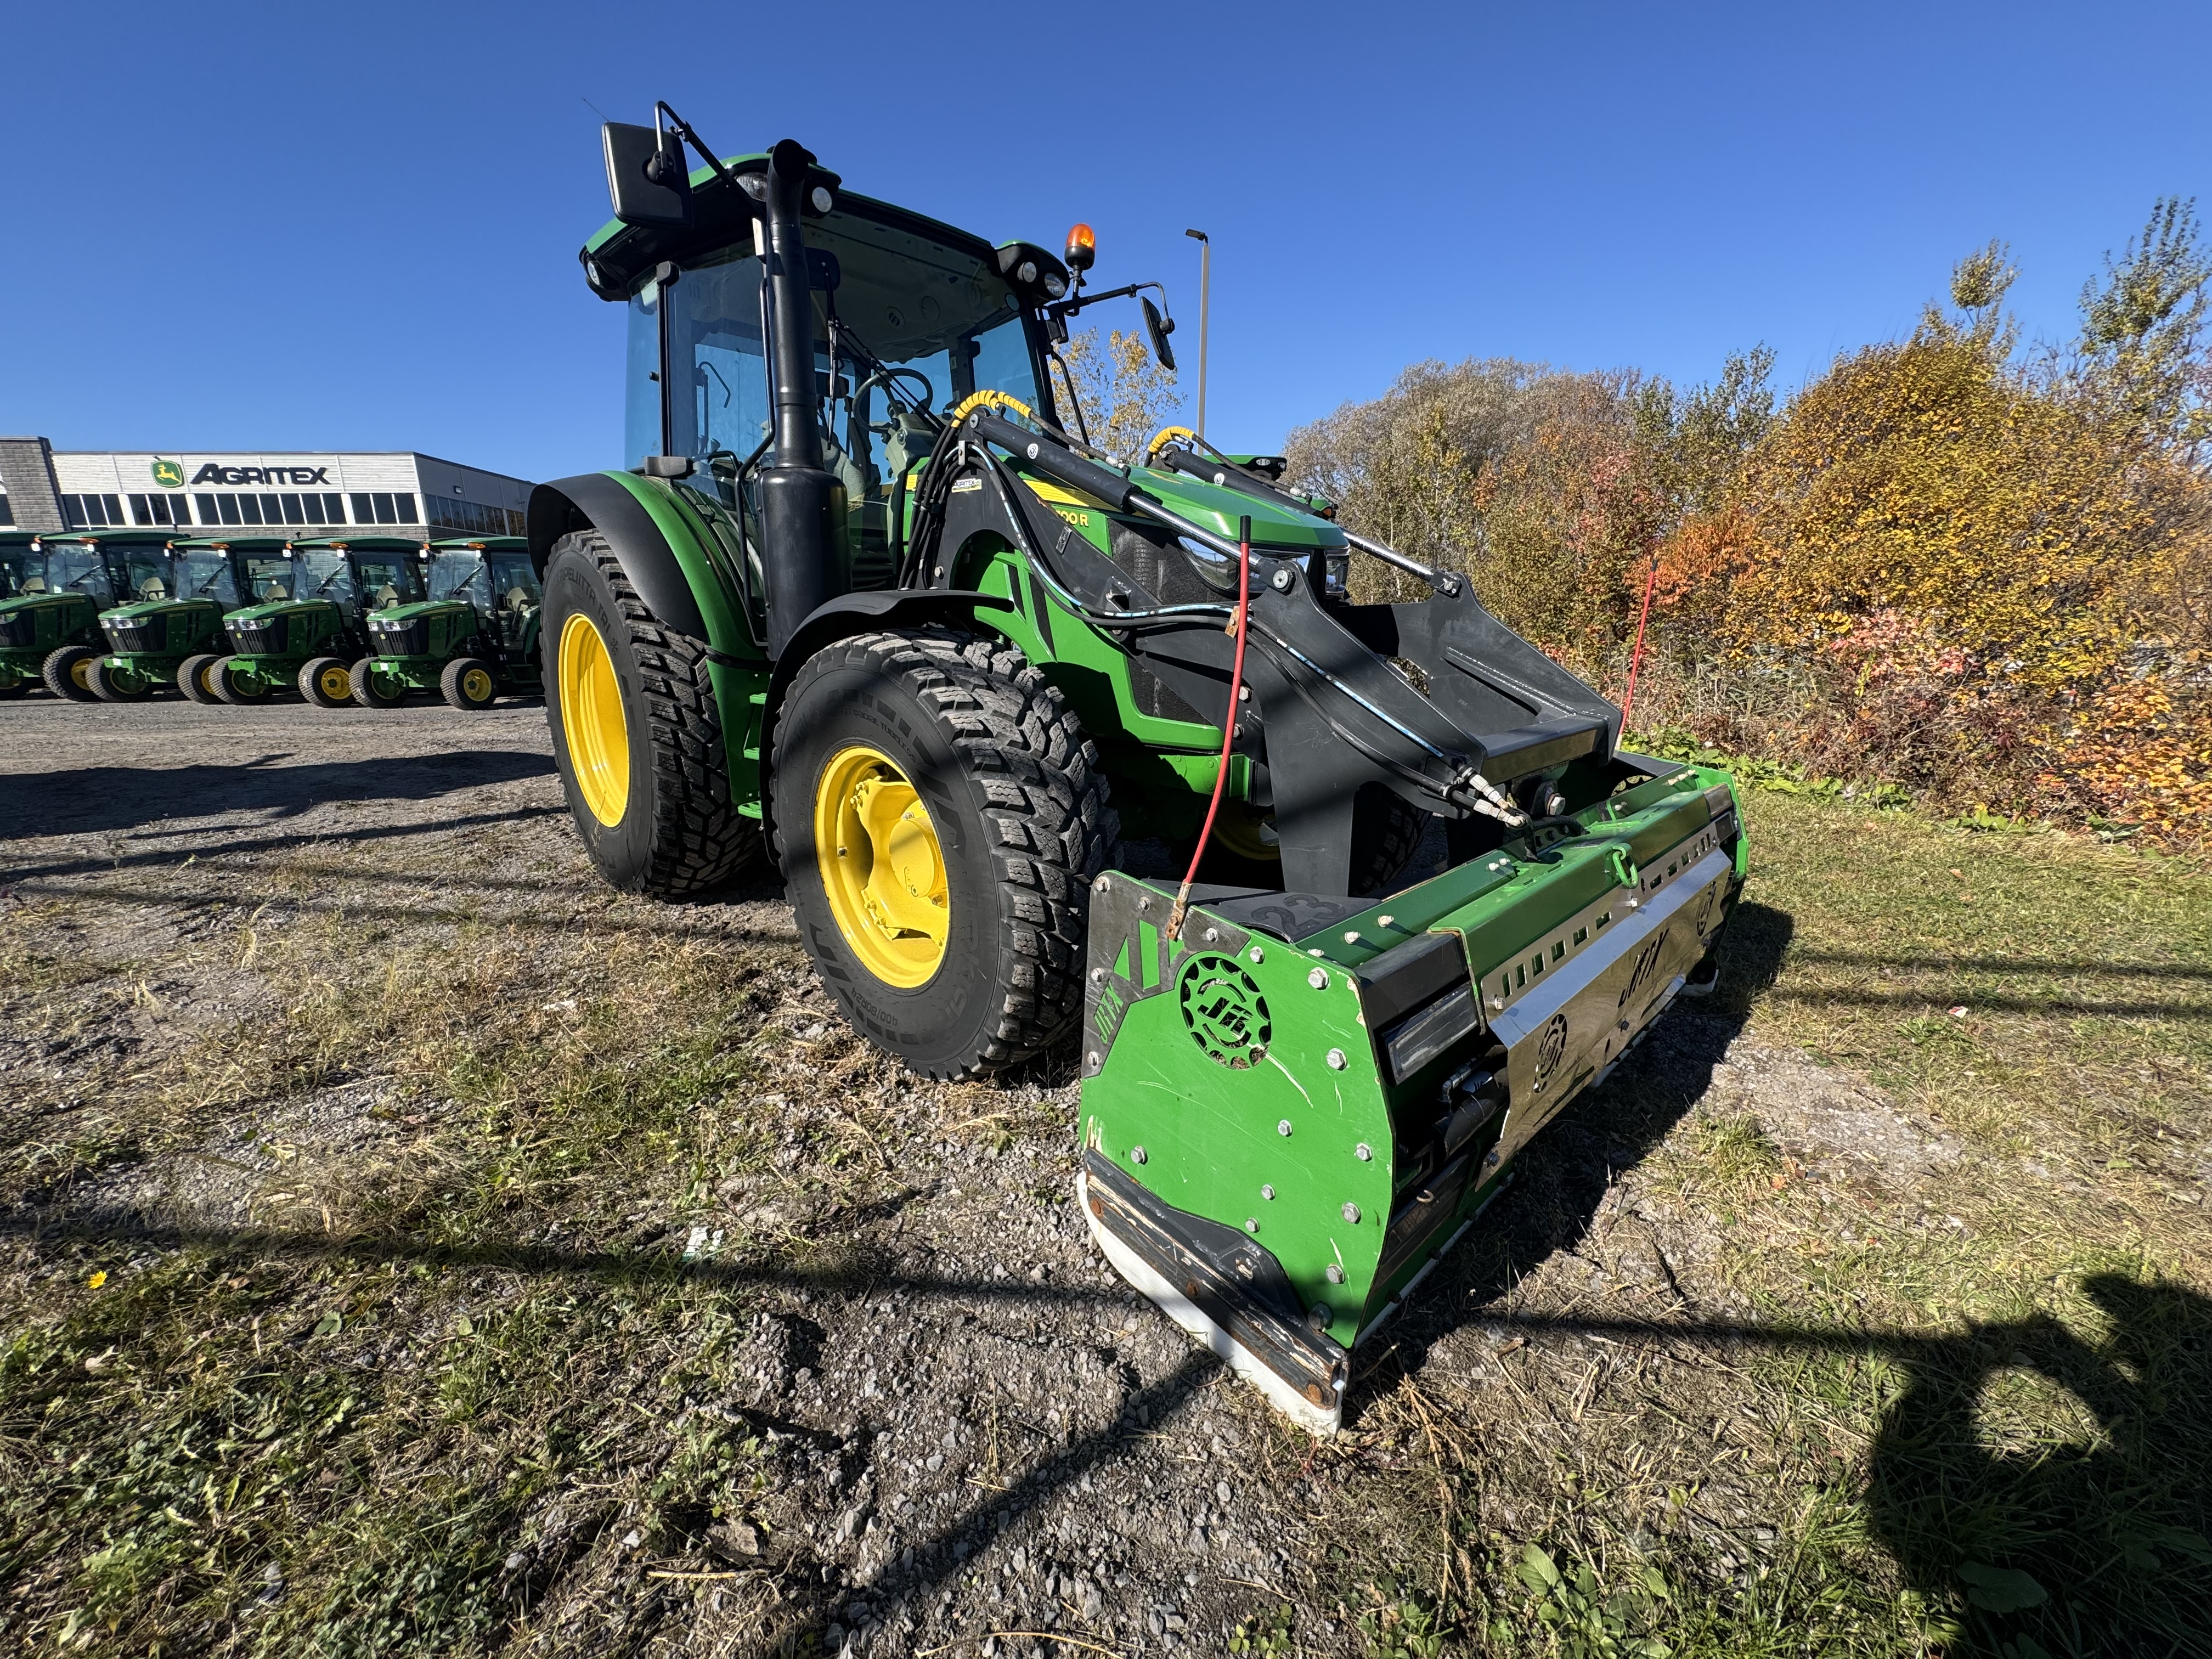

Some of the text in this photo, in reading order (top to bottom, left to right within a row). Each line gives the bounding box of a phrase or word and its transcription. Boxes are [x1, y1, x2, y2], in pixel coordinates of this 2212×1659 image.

[190, 463, 331, 485] AGRITEX
[880, 721, 916, 763] TUBELESS
[1250, 894, 1346, 936] 23
[851, 987, 898, 1026] 400/80R24
